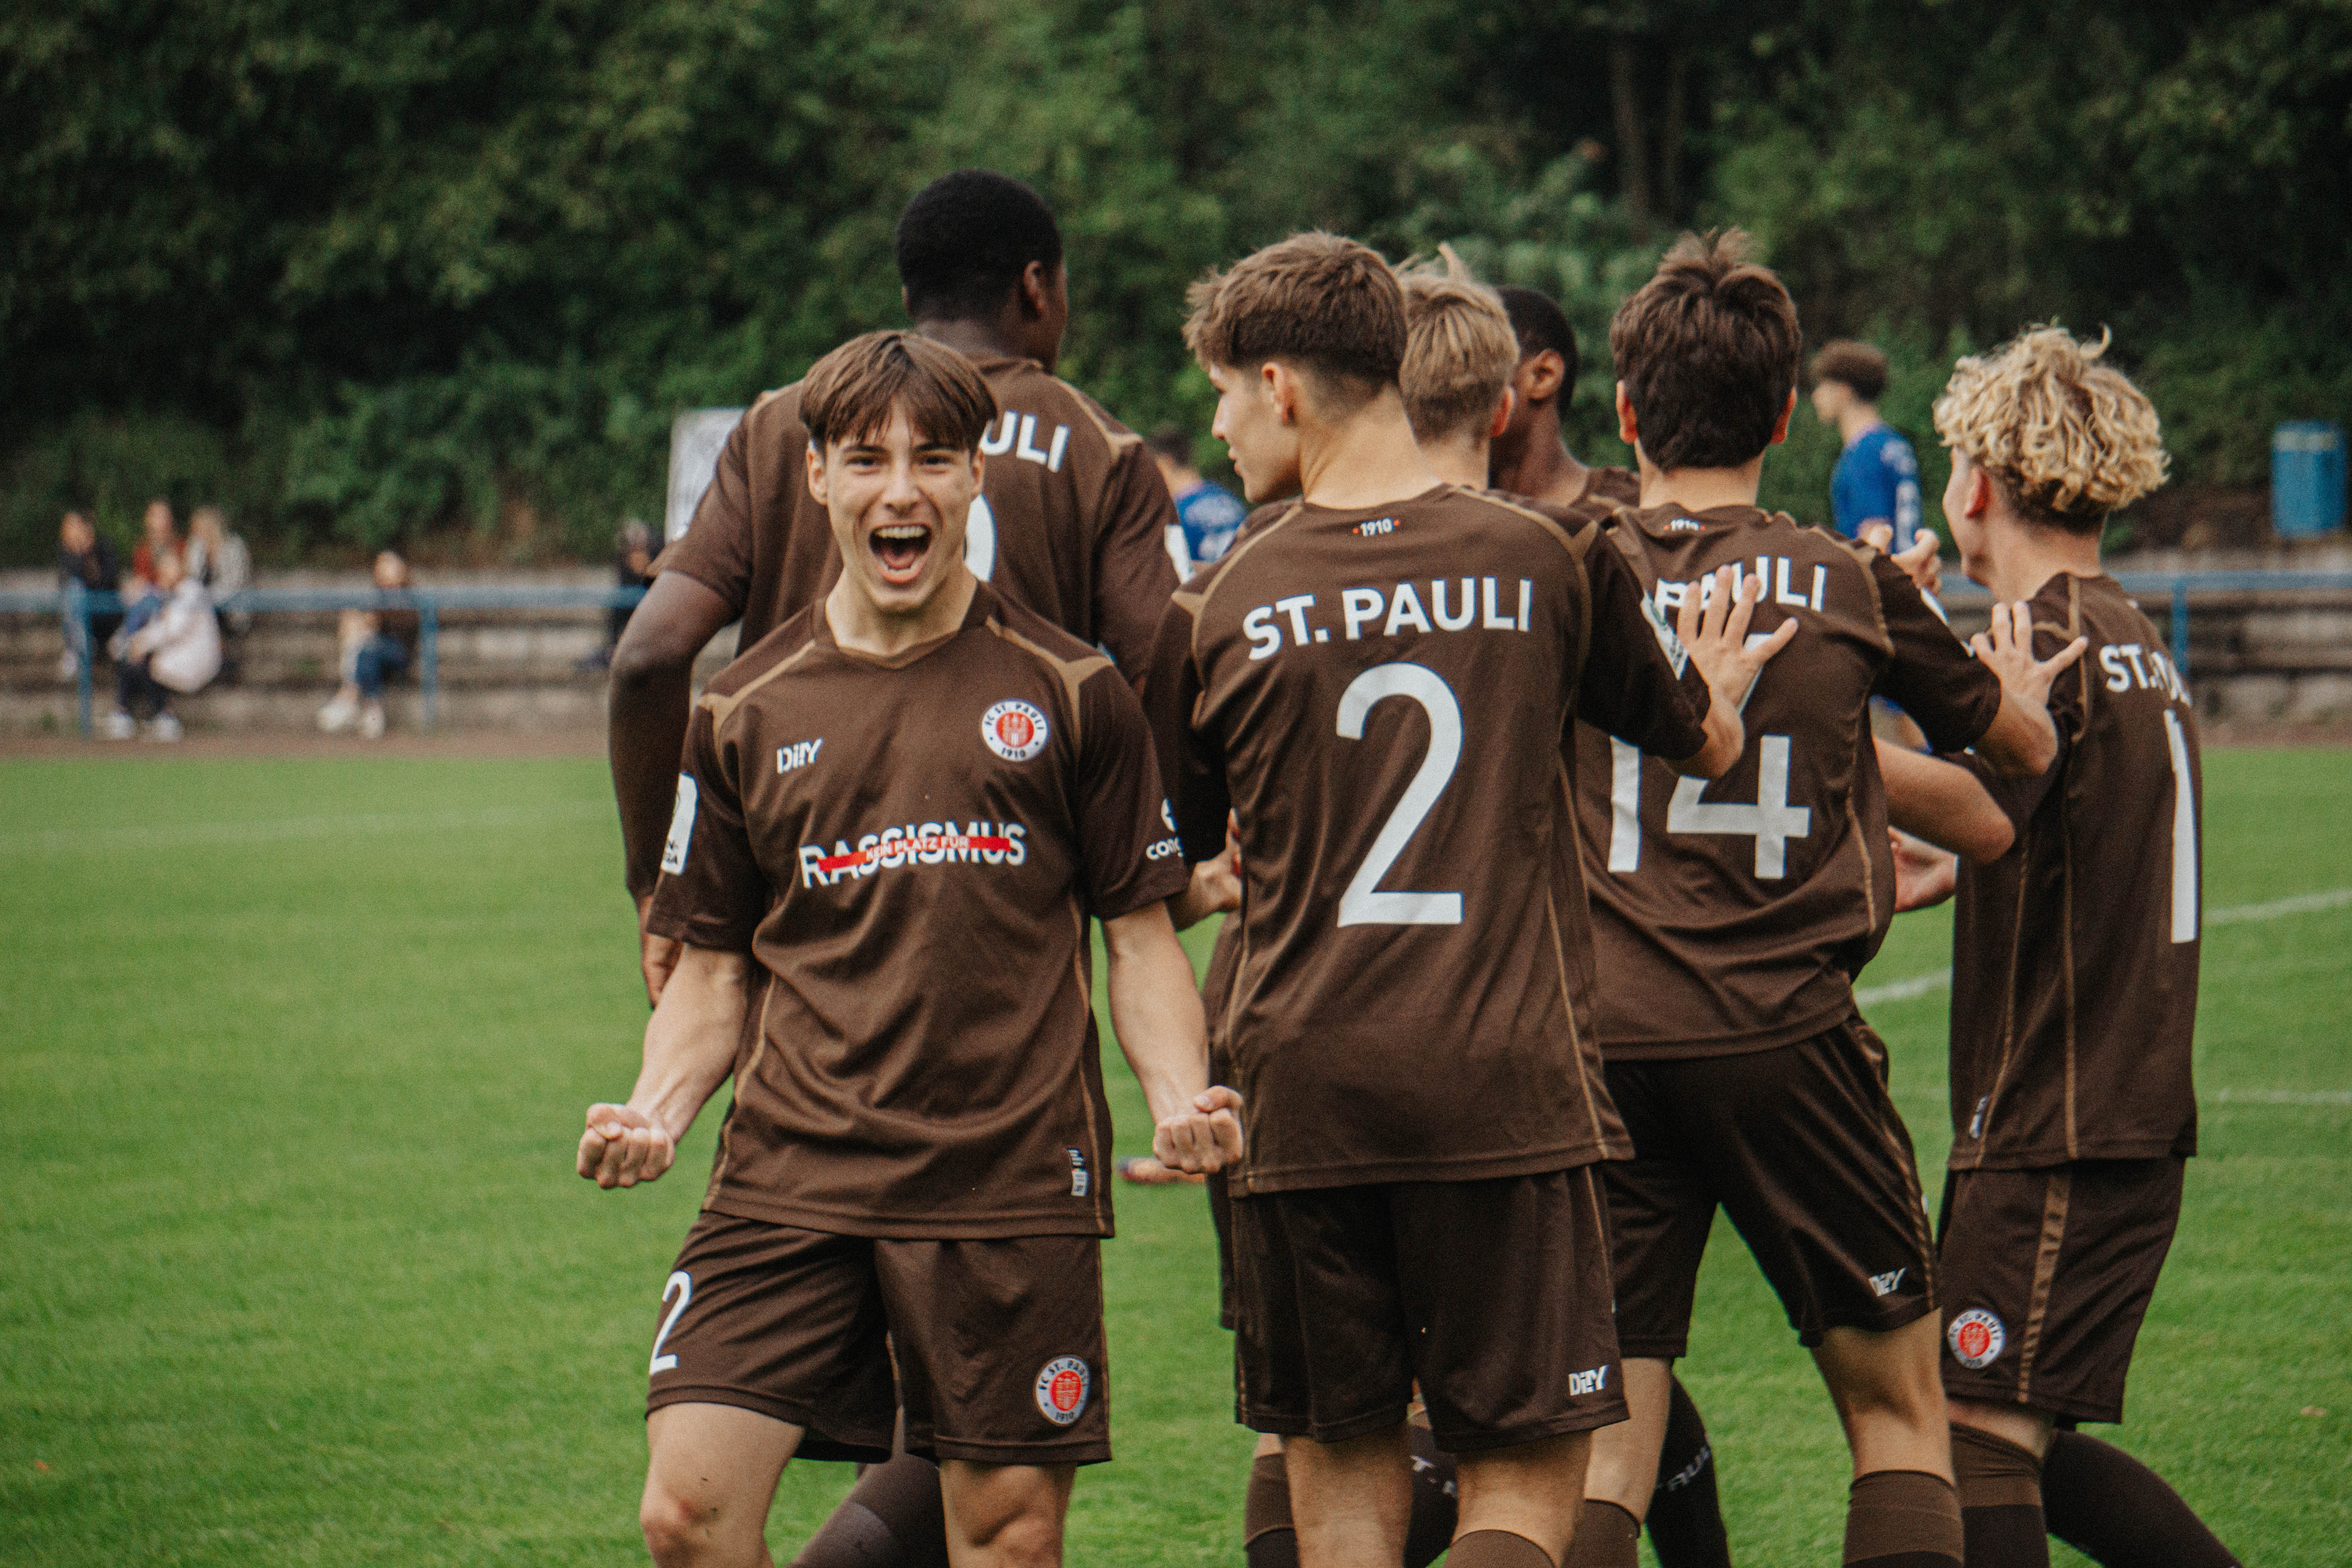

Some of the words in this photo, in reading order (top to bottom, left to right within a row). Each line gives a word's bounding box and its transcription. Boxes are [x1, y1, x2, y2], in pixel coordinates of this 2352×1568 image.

[980, 410, 1070, 473] ULI
[1360, 518, 1394, 537] 1910
[1243, 594, 1330, 660] ST.
[1342, 576, 1532, 640] PAULI
[2099, 643, 2157, 692] ST.
[985, 715, 995, 726] FC
[1016, 704, 1044, 730] PAULI
[1002, 747, 1026, 759] 1910
[1608, 633, 1811, 879] 14
[1336, 662, 1464, 927] 2
[799, 820, 1026, 889] RASSISMUS
[895, 837, 938, 852] PLATZ
[649, 1270, 693, 1376] 2
[1039, 1376, 1049, 1390] FC
